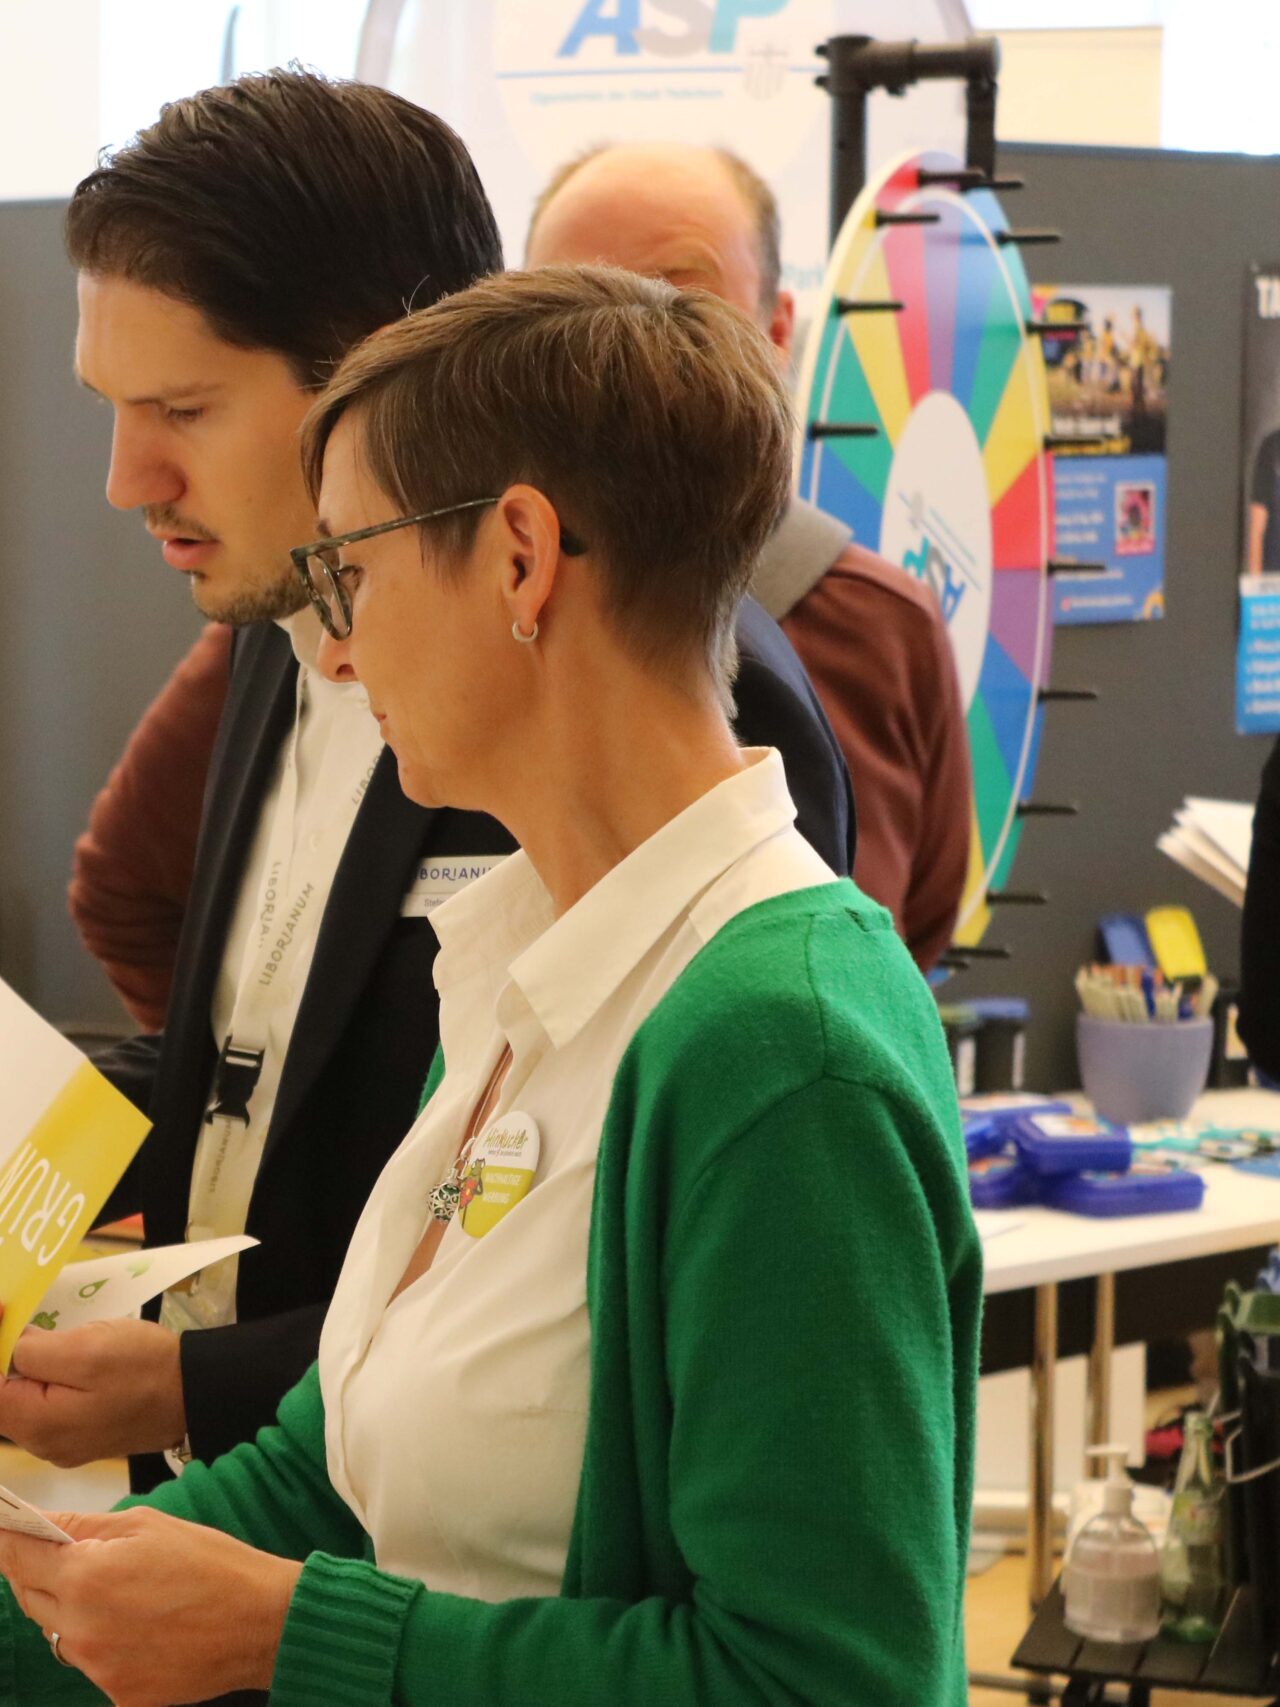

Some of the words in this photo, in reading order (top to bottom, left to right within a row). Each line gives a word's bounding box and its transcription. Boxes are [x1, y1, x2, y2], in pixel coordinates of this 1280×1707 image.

[554, 0, 790, 58] ASP
[258, 861, 281, 949] LIBORIA
[419, 866, 492, 882] BORIAN
[258, 882, 315, 986] LIBORIANUM
